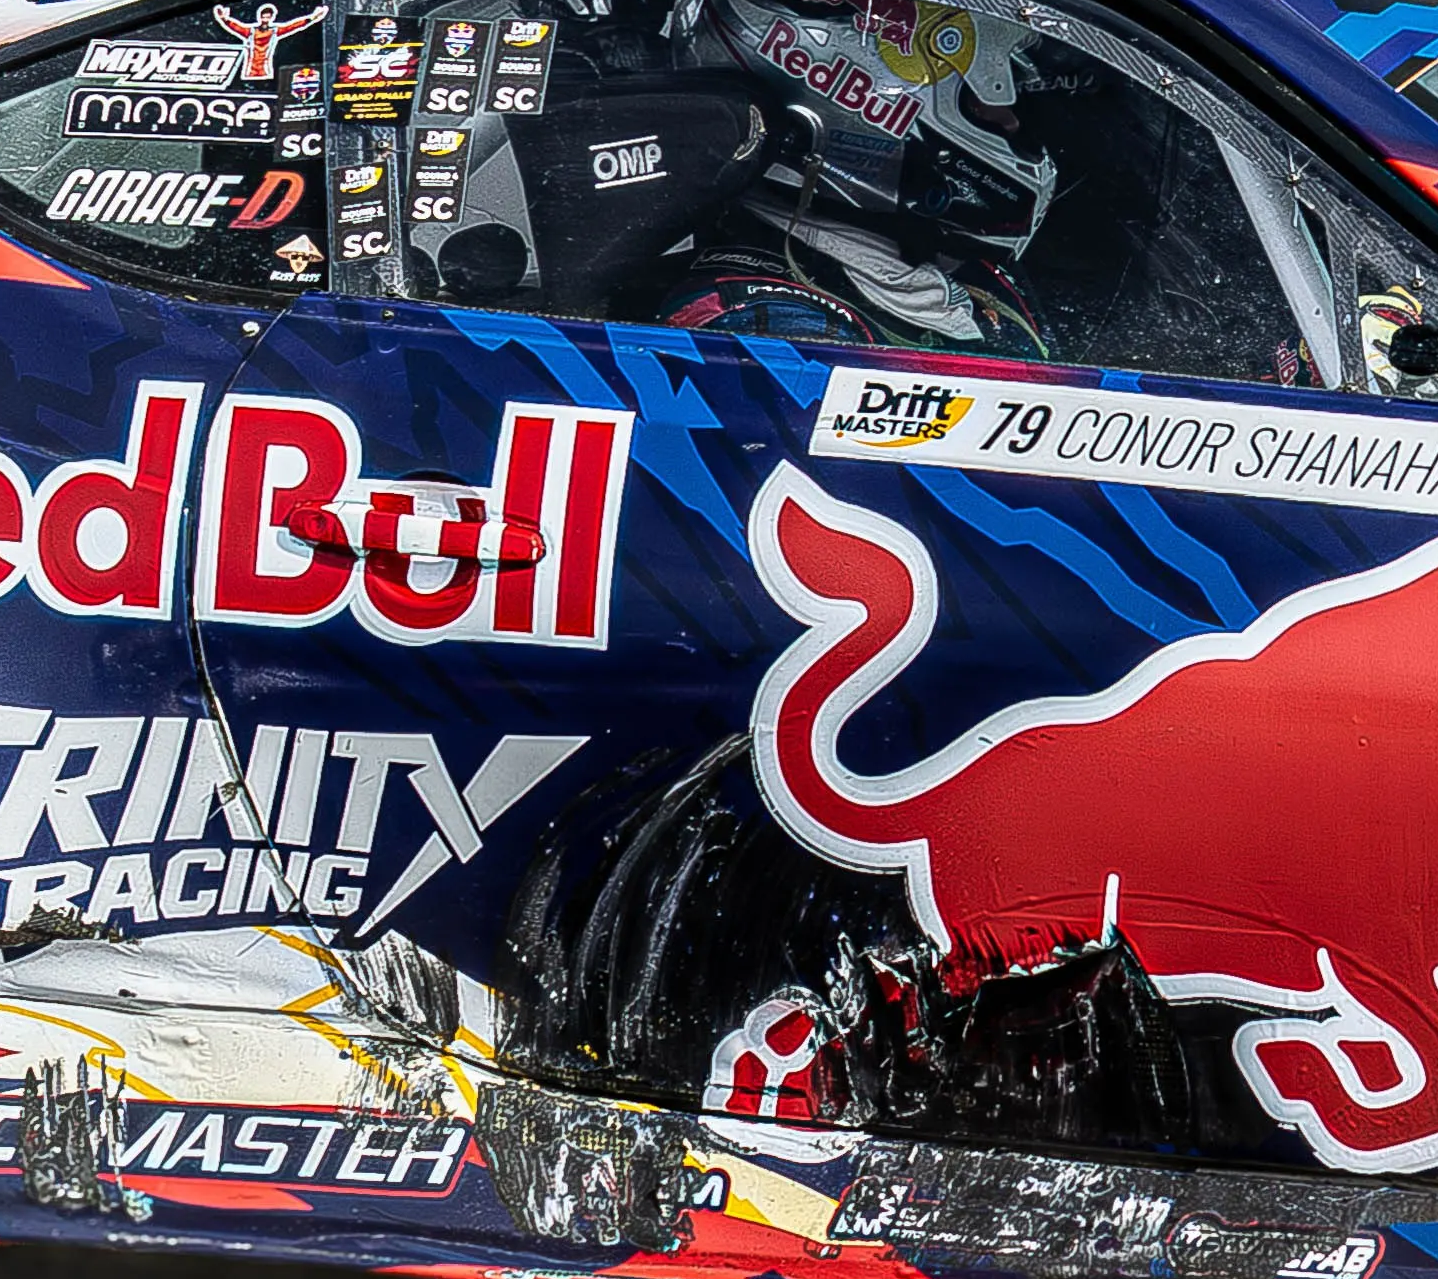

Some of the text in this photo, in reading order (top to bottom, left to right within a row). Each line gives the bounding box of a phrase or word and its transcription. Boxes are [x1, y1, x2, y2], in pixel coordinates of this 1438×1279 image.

[86, 47, 242, 79] MAXFLO
[149, 74, 228, 84] MOTORSPORT
[758, 18, 923, 138] Red Bull
[79, 94, 271, 127] moose
[427, 88, 470, 112] SC
[493, 87, 537, 111] SC
[281, 133, 322, 158] SC
[593, 143, 661, 180] OMP
[46, 168, 305, 229] GARAGE-D
[412, 197, 454, 220] SC
[343, 232, 380, 258] SC
[860, 382, 956, 419] Drift
[833, 414, 948, 441] MASTERS
[980, 402, 1053, 453] 79
[1058, 409, 1234, 471] CONOR
[212, 404, 620, 638] Bull
